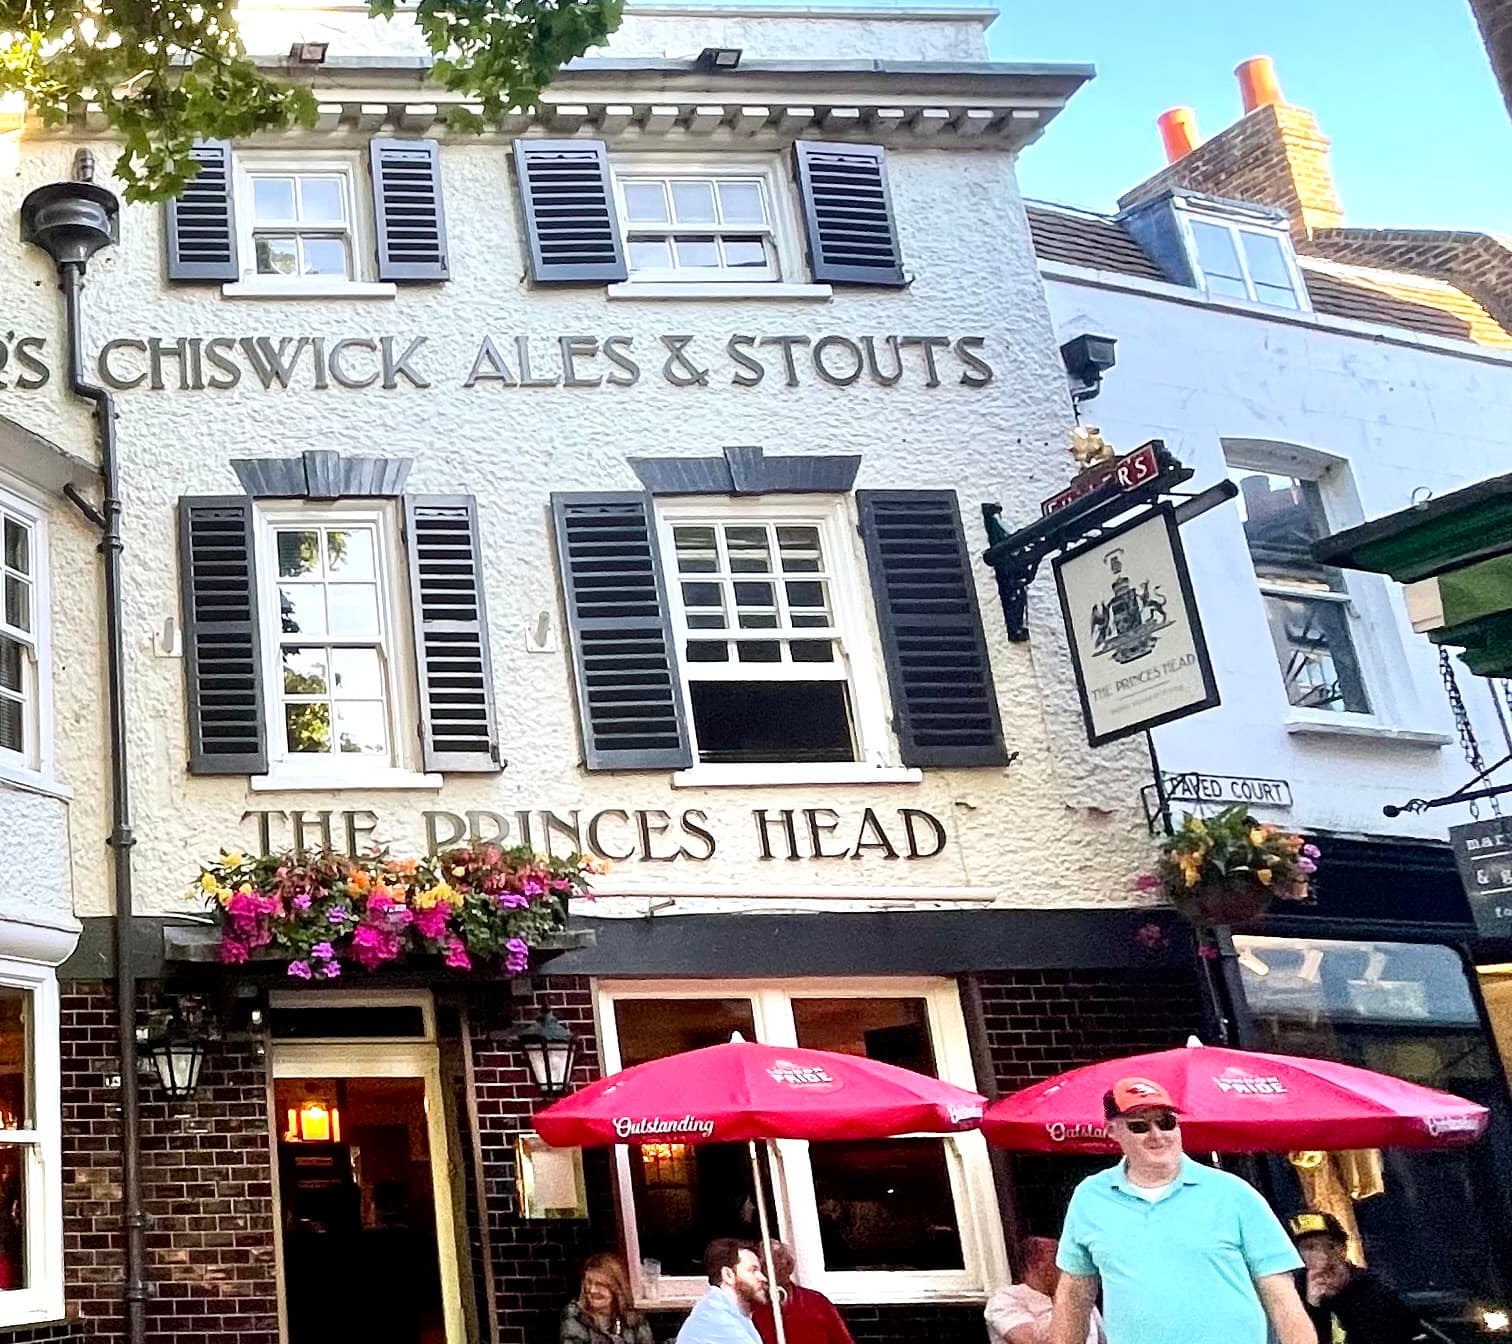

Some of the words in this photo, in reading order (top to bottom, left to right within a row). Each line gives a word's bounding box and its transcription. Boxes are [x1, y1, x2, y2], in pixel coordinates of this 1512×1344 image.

[97, 335, 431, 391] CHISWICK
[463, 334, 642, 389] ALES
[660, 334, 710, 388] &
[729, 333, 994, 389] STOUTS
[1230, 780, 1283, 802] COURT
[239, 808, 390, 858] THE
[421, 808, 716, 862] PRINCES
[752, 807, 948, 862] HEAD
[612, 1115, 715, 1138] Outstanding
